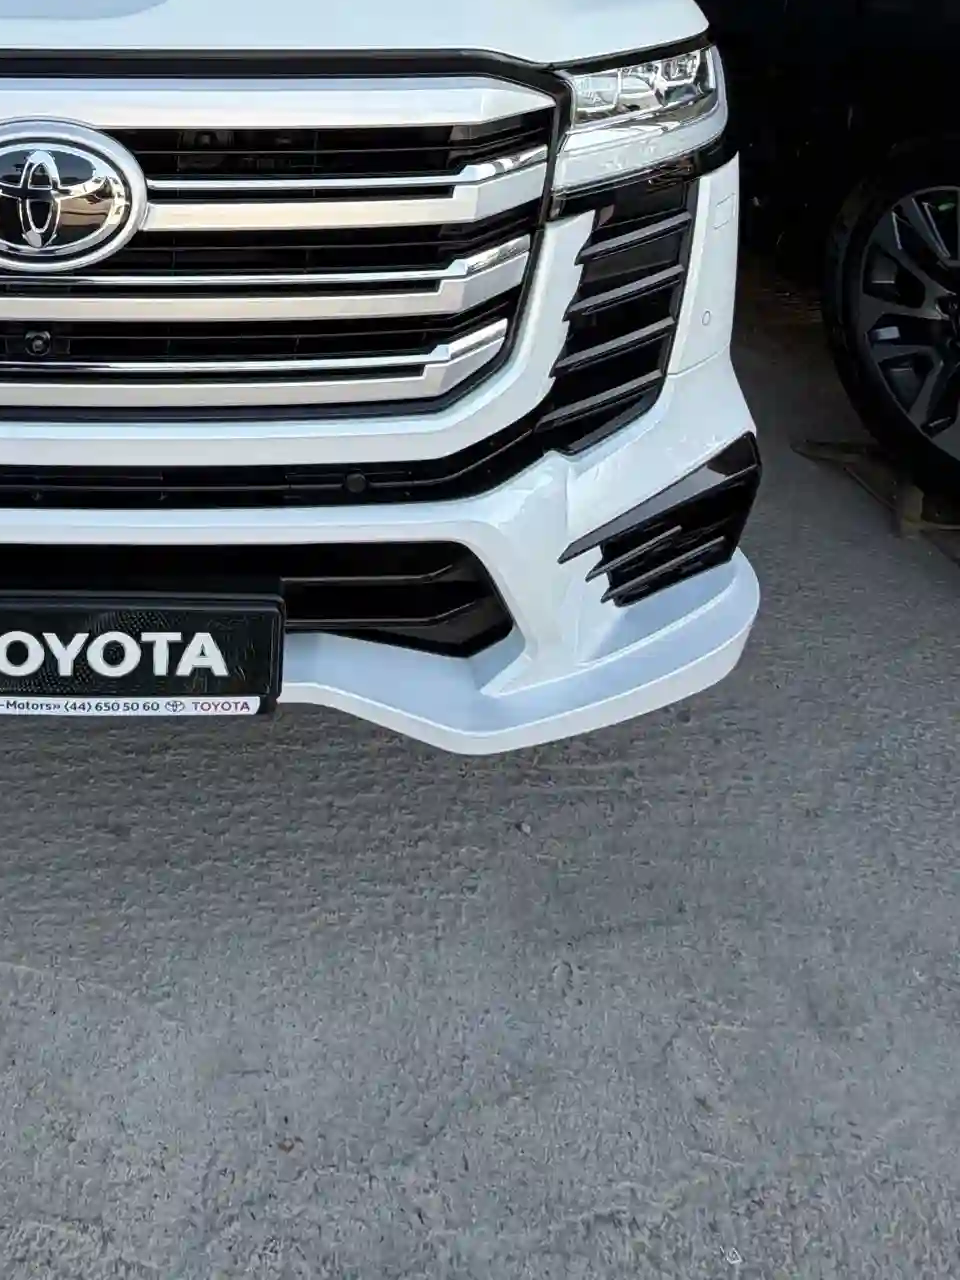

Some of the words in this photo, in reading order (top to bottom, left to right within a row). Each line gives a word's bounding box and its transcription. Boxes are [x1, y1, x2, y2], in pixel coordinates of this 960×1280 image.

[63, 701, 92, 712] (44)
[94, 701, 121, 712] 650
[123, 701, 140, 712] 50
[143, 701, 160, 712] 60
[191, 701, 251, 712] TOYOTA
